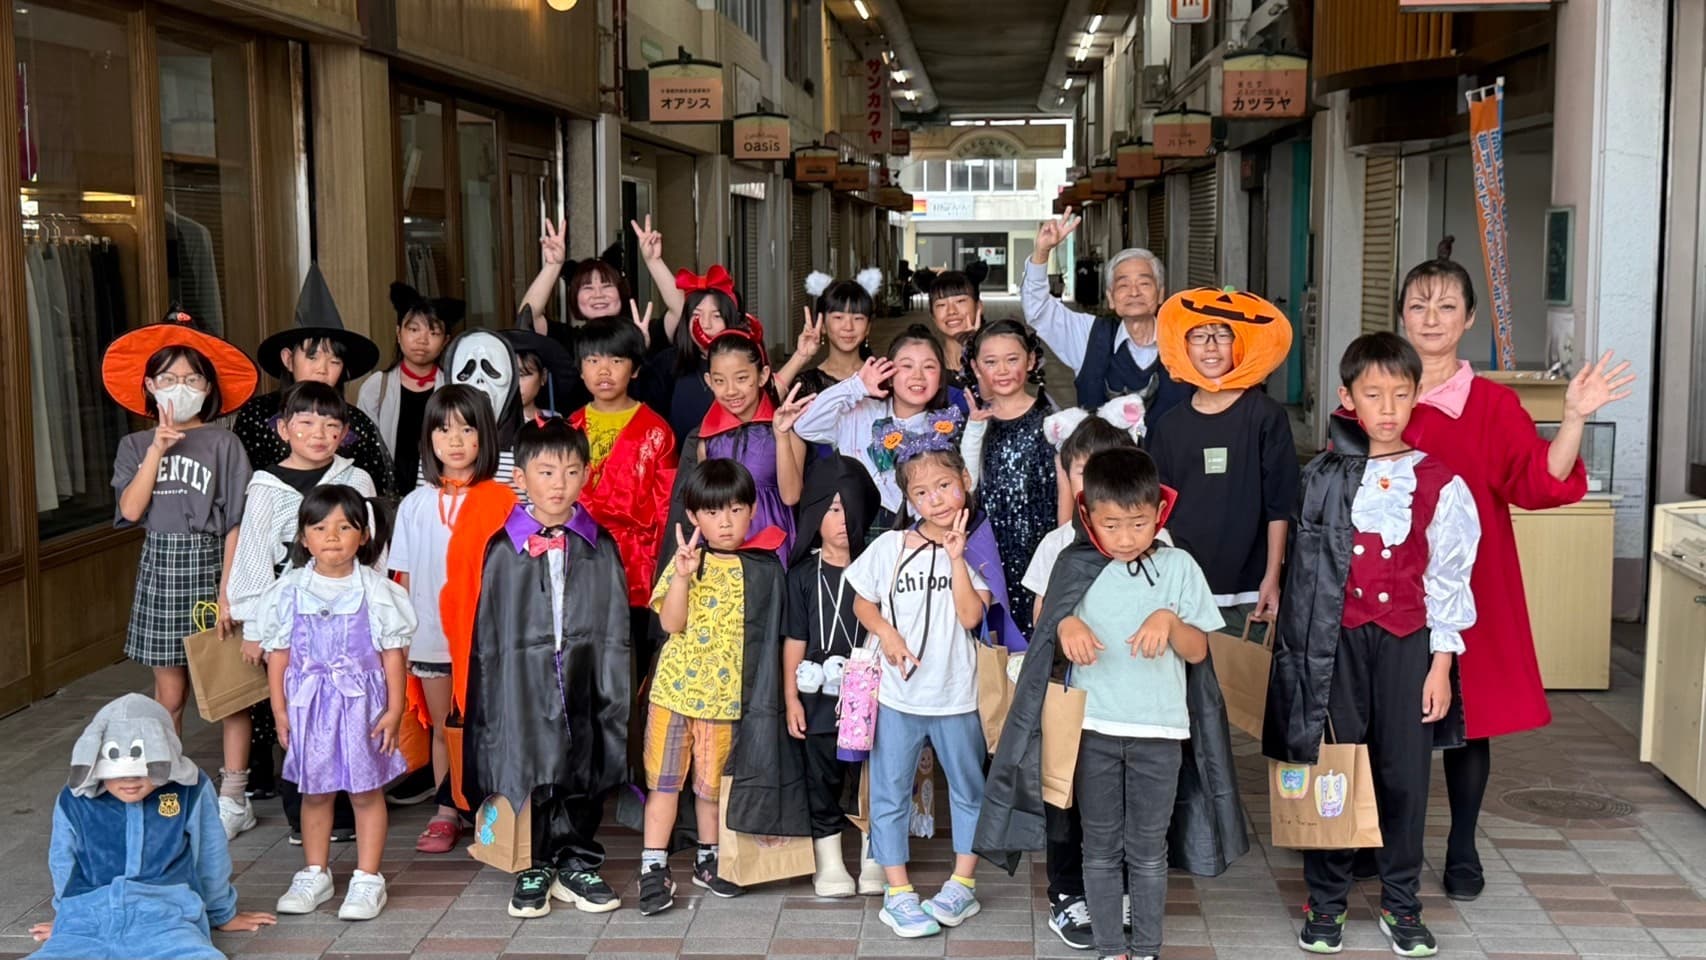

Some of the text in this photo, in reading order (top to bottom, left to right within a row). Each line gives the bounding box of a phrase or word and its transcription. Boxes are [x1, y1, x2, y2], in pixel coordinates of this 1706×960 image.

[661, 97, 711, 110] オアシス
[866, 58, 882, 144] サンカクヤ
[1232, 96, 1291, 111] カツラヤ
[743, 140, 780, 152] oasis
[138, 455, 212, 495] ENTLY
